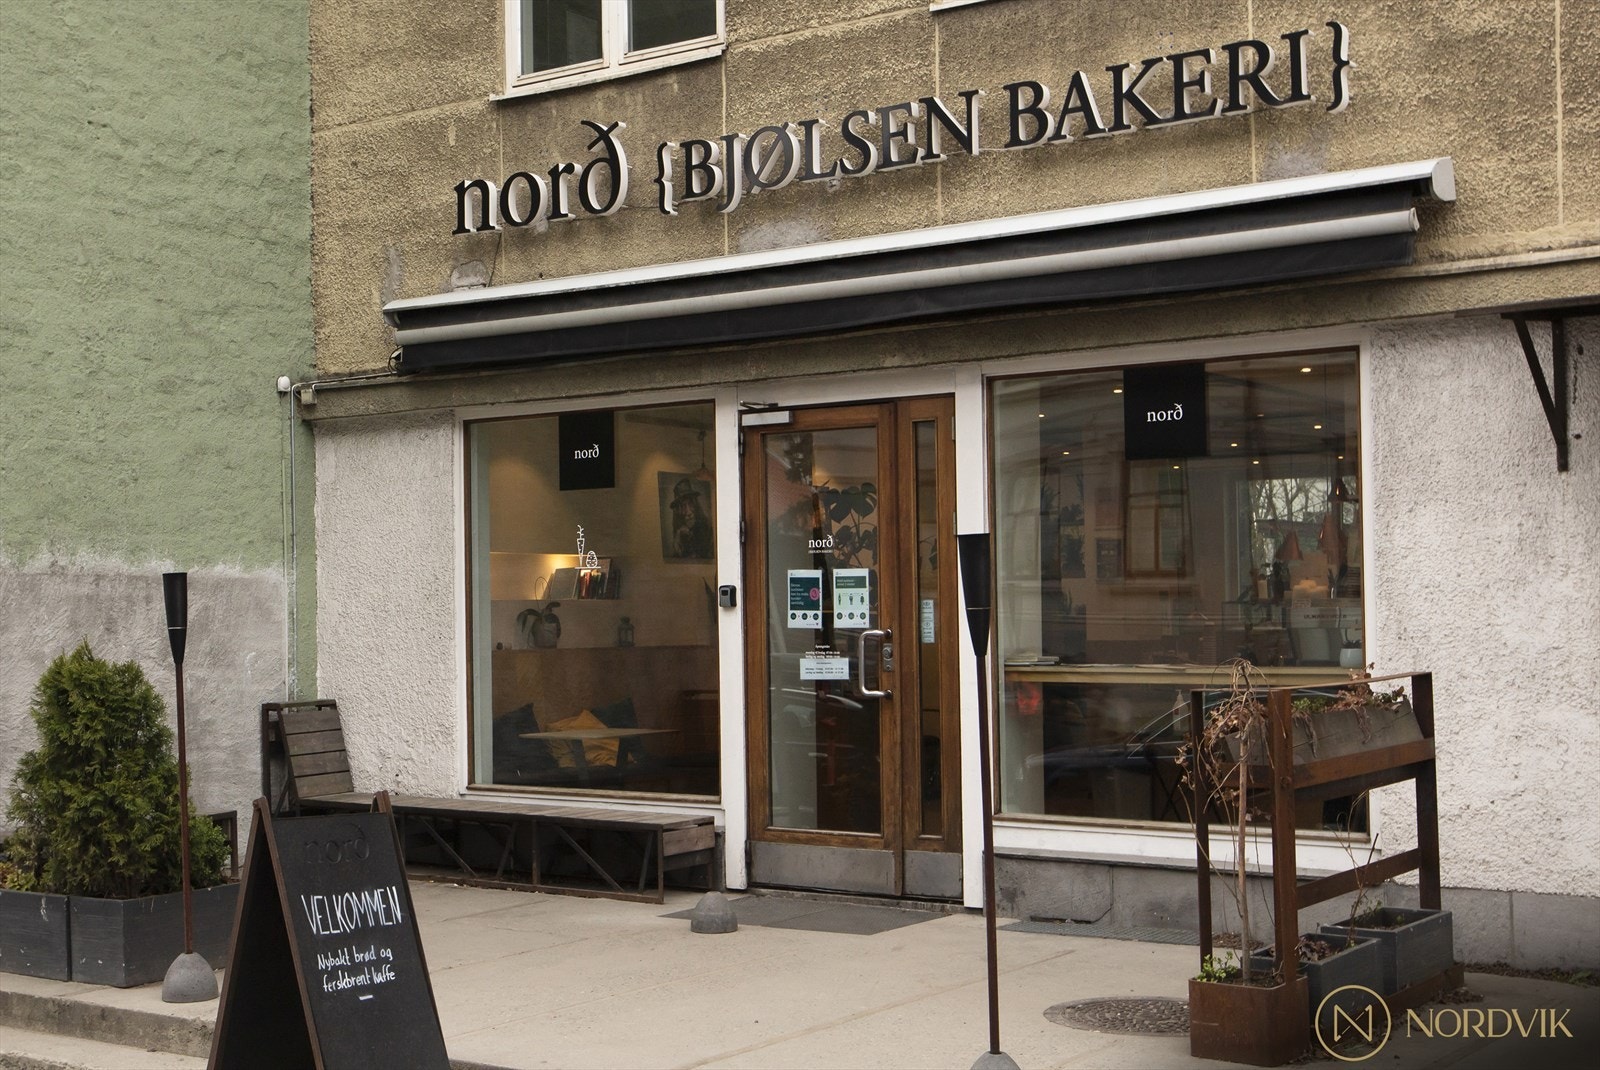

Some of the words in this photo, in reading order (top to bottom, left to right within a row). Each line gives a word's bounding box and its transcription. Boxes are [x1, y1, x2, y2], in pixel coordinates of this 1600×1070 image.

[452, 120, 627, 235] norð
[1146, 403, 1184, 423] norð
[574, 443, 600, 460] norð
[808, 534, 834, 548] norð
[301, 886, 402, 935] VELKOMMEN
[317, 947, 351, 971] Nybakt
[353, 945, 377, 962] brød
[380, 948, 393, 961] og
[323, 967, 371, 992] ferskbrent
[371, 964, 396, 985] kaffe
